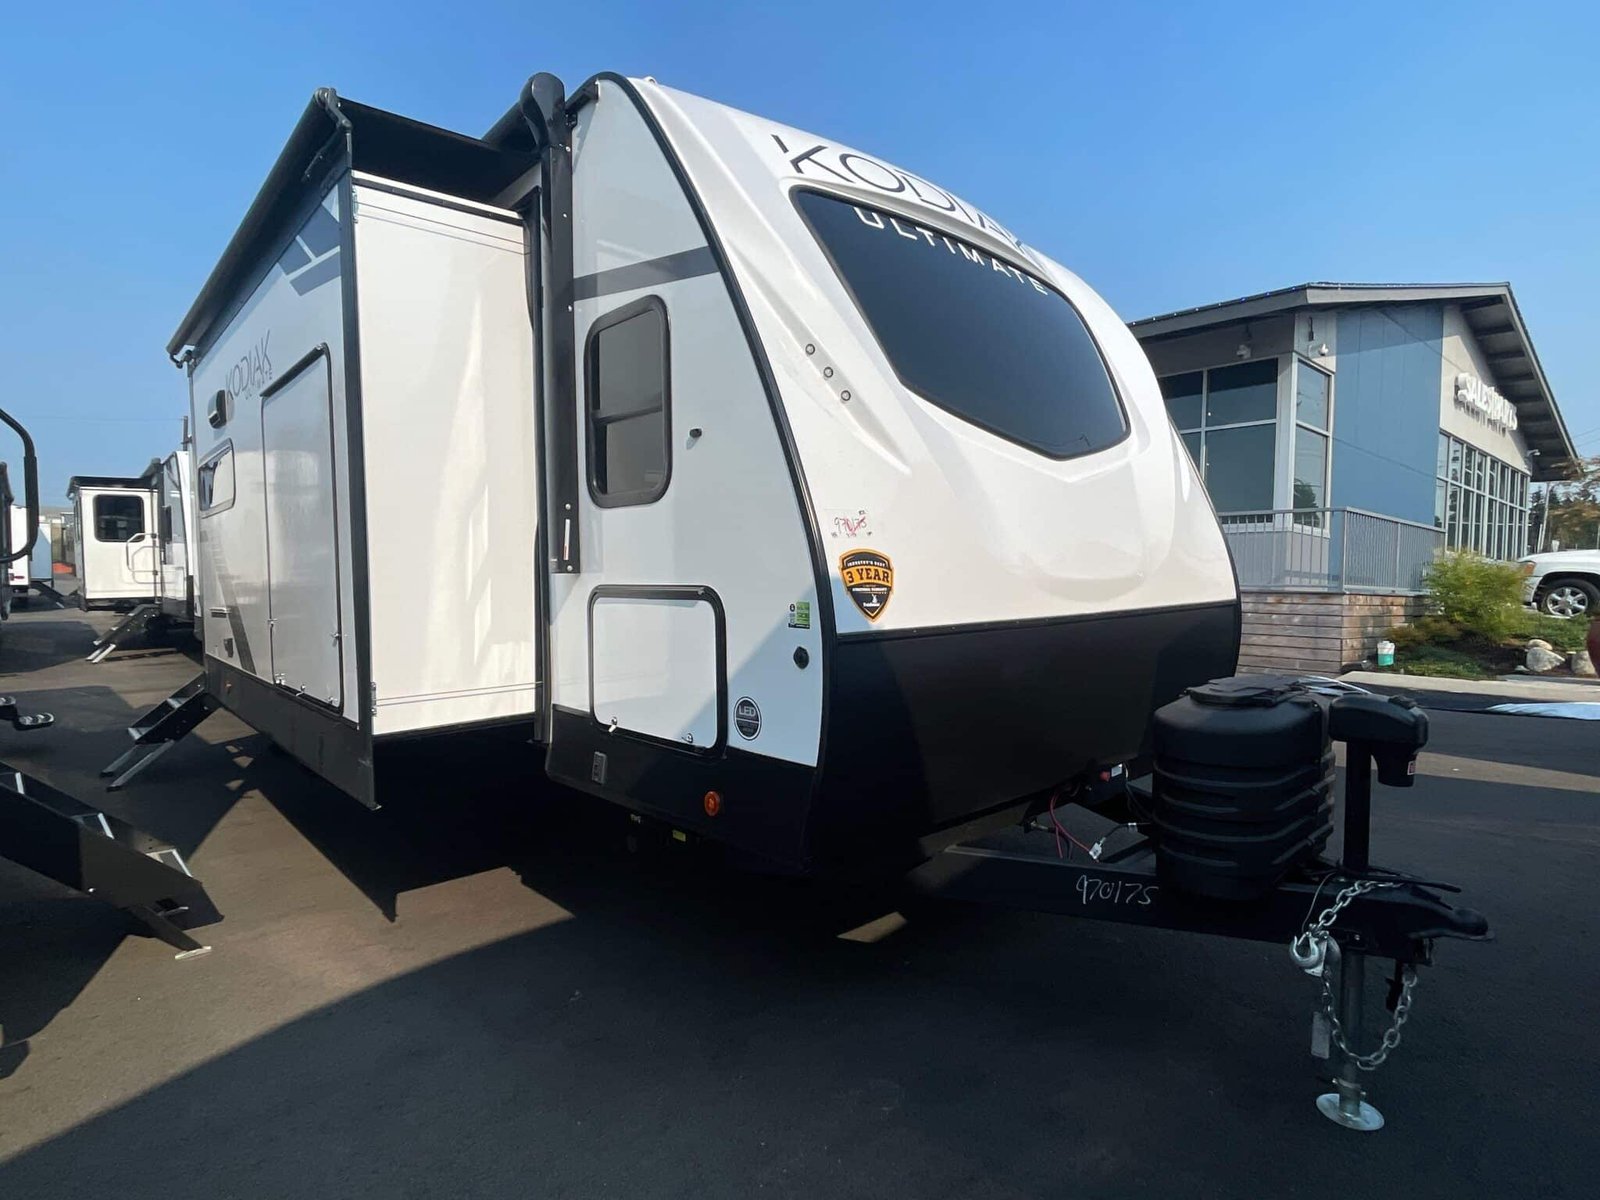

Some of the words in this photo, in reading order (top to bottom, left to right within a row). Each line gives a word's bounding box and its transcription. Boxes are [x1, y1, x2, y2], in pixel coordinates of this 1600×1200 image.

[852, 206, 1048, 295] ULTIMATE
[225, 329, 272, 400] KODIAK
[846, 571, 855, 583] 3
[856, 567, 890, 583] YEAR
[738, 705, 756, 717] LED
[1075, 874, 1159, 905] 970175
